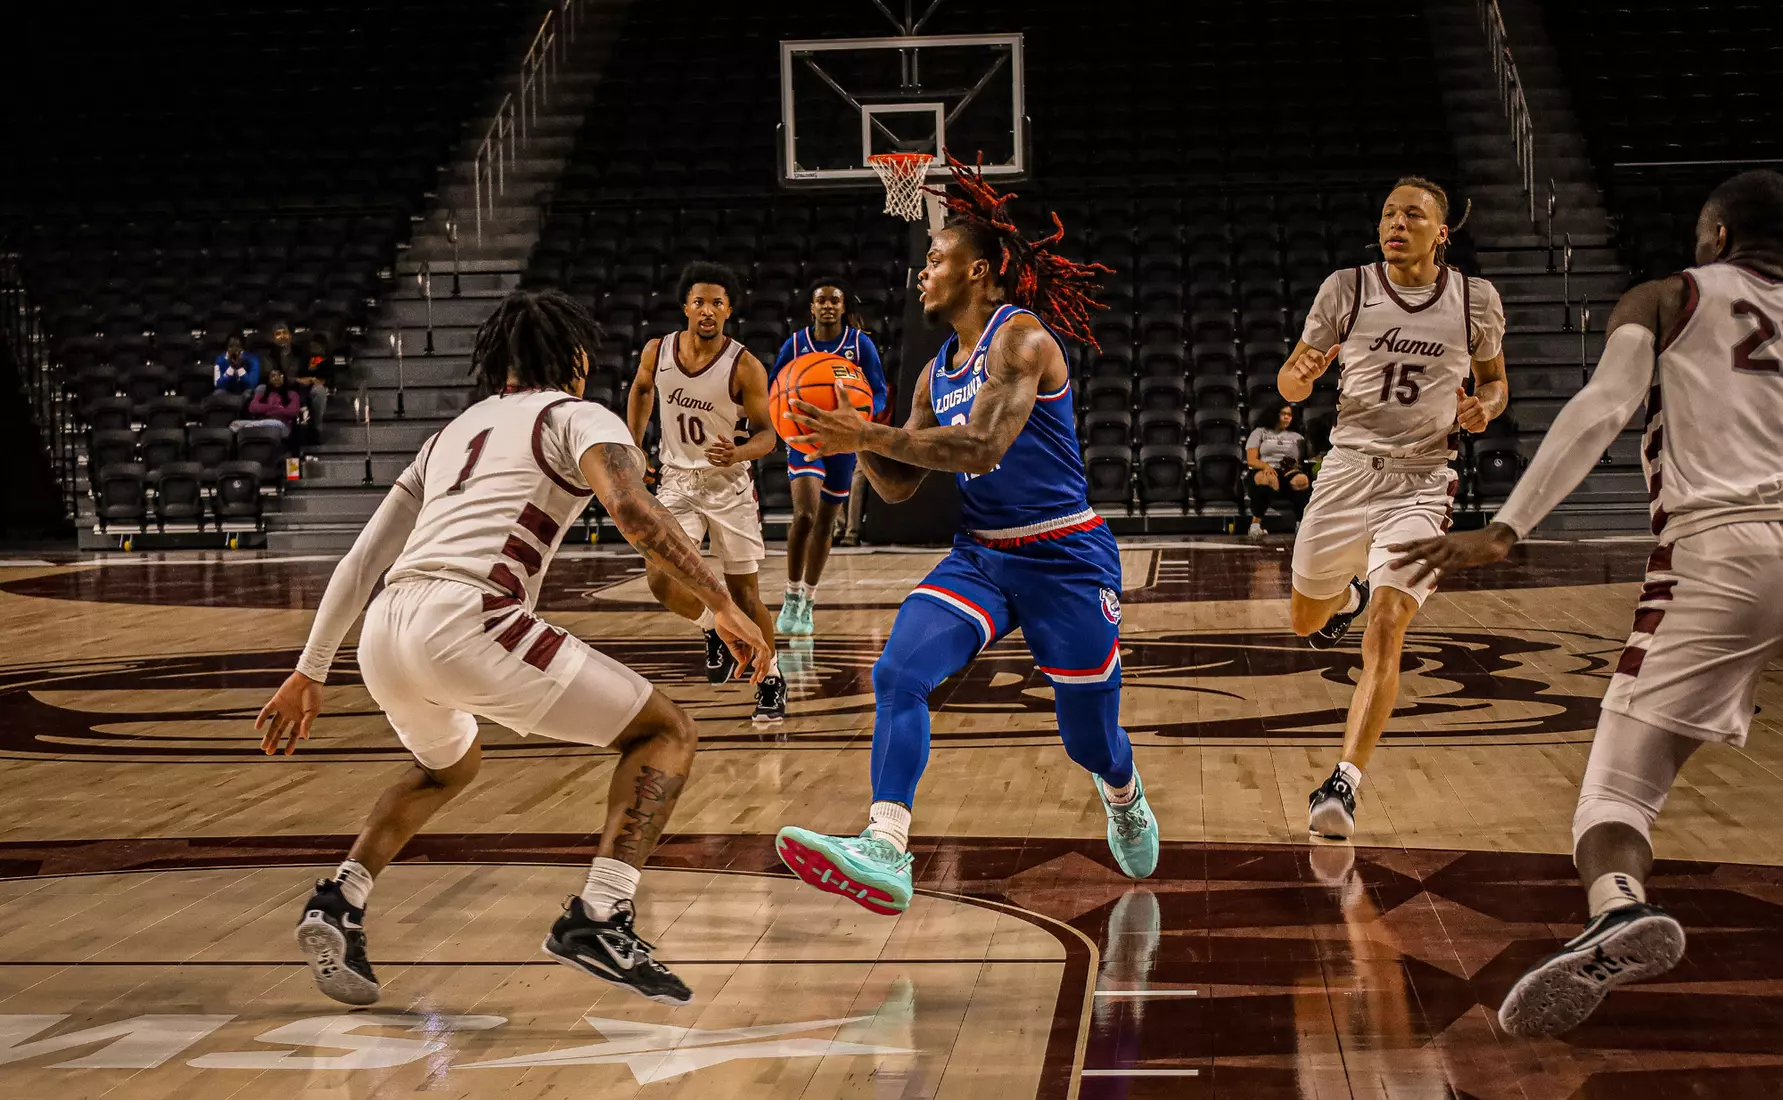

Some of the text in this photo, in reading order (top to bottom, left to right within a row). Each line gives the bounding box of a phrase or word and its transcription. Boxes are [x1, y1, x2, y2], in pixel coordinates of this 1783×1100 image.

[1368, 326, 1446, 358] Aamu
[1730, 298, 1783, 376] 2
[666, 387, 715, 413] Aamu
[1379, 361, 1427, 407] 15
[676, 412, 707, 446] 10
[446, 426, 495, 497] 1
